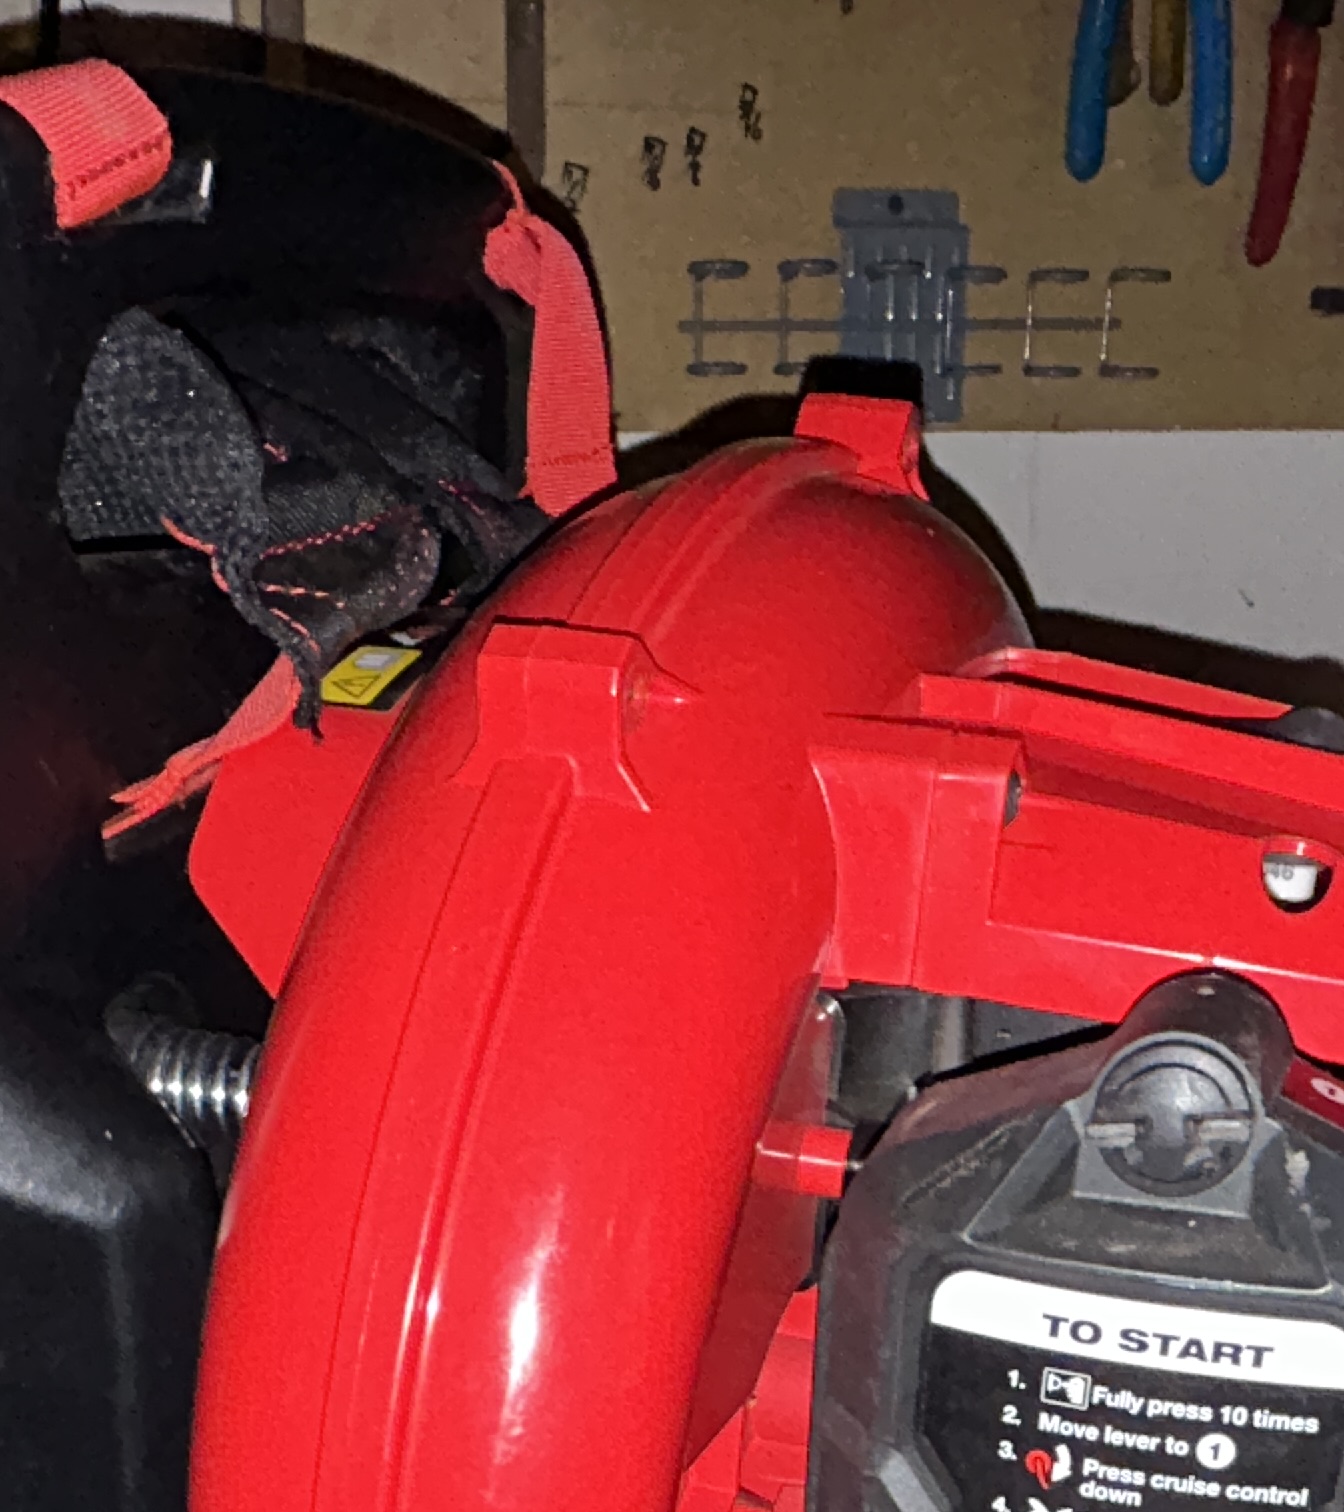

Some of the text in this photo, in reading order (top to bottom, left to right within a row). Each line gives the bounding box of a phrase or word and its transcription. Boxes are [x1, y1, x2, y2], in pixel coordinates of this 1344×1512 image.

[1042, 1312, 1275, 1368] TO START
[1008, 1368, 1319, 1434] 1. Fully press 10 times
[1001, 1404, 1021, 1427] 2.
[1037, 1411, 1099, 1441] Move
[1105, 1424, 1161, 1453] lever
[1165, 1436, 1189, 1457] to
[998, 1440, 1309, 1508] 3. Press cruise control
[1078, 1480, 1143, 1508] down
